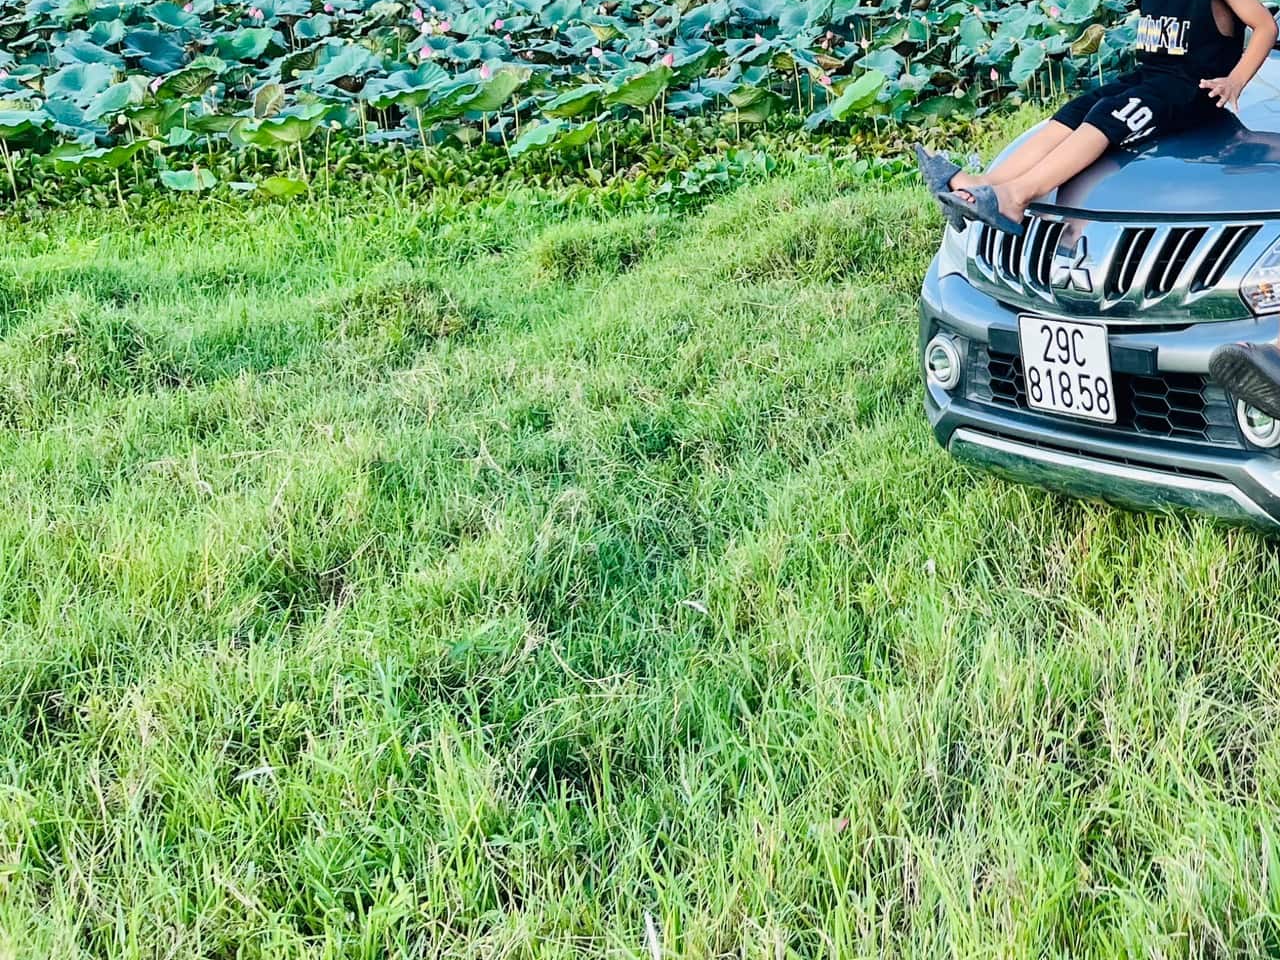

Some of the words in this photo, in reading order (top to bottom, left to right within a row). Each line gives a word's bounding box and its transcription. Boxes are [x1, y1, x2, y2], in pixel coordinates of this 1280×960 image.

[1111, 97, 1153, 132] 10
[1040, 324, 1087, 367] 29C
[1028, 365, 1110, 415] 818.58
